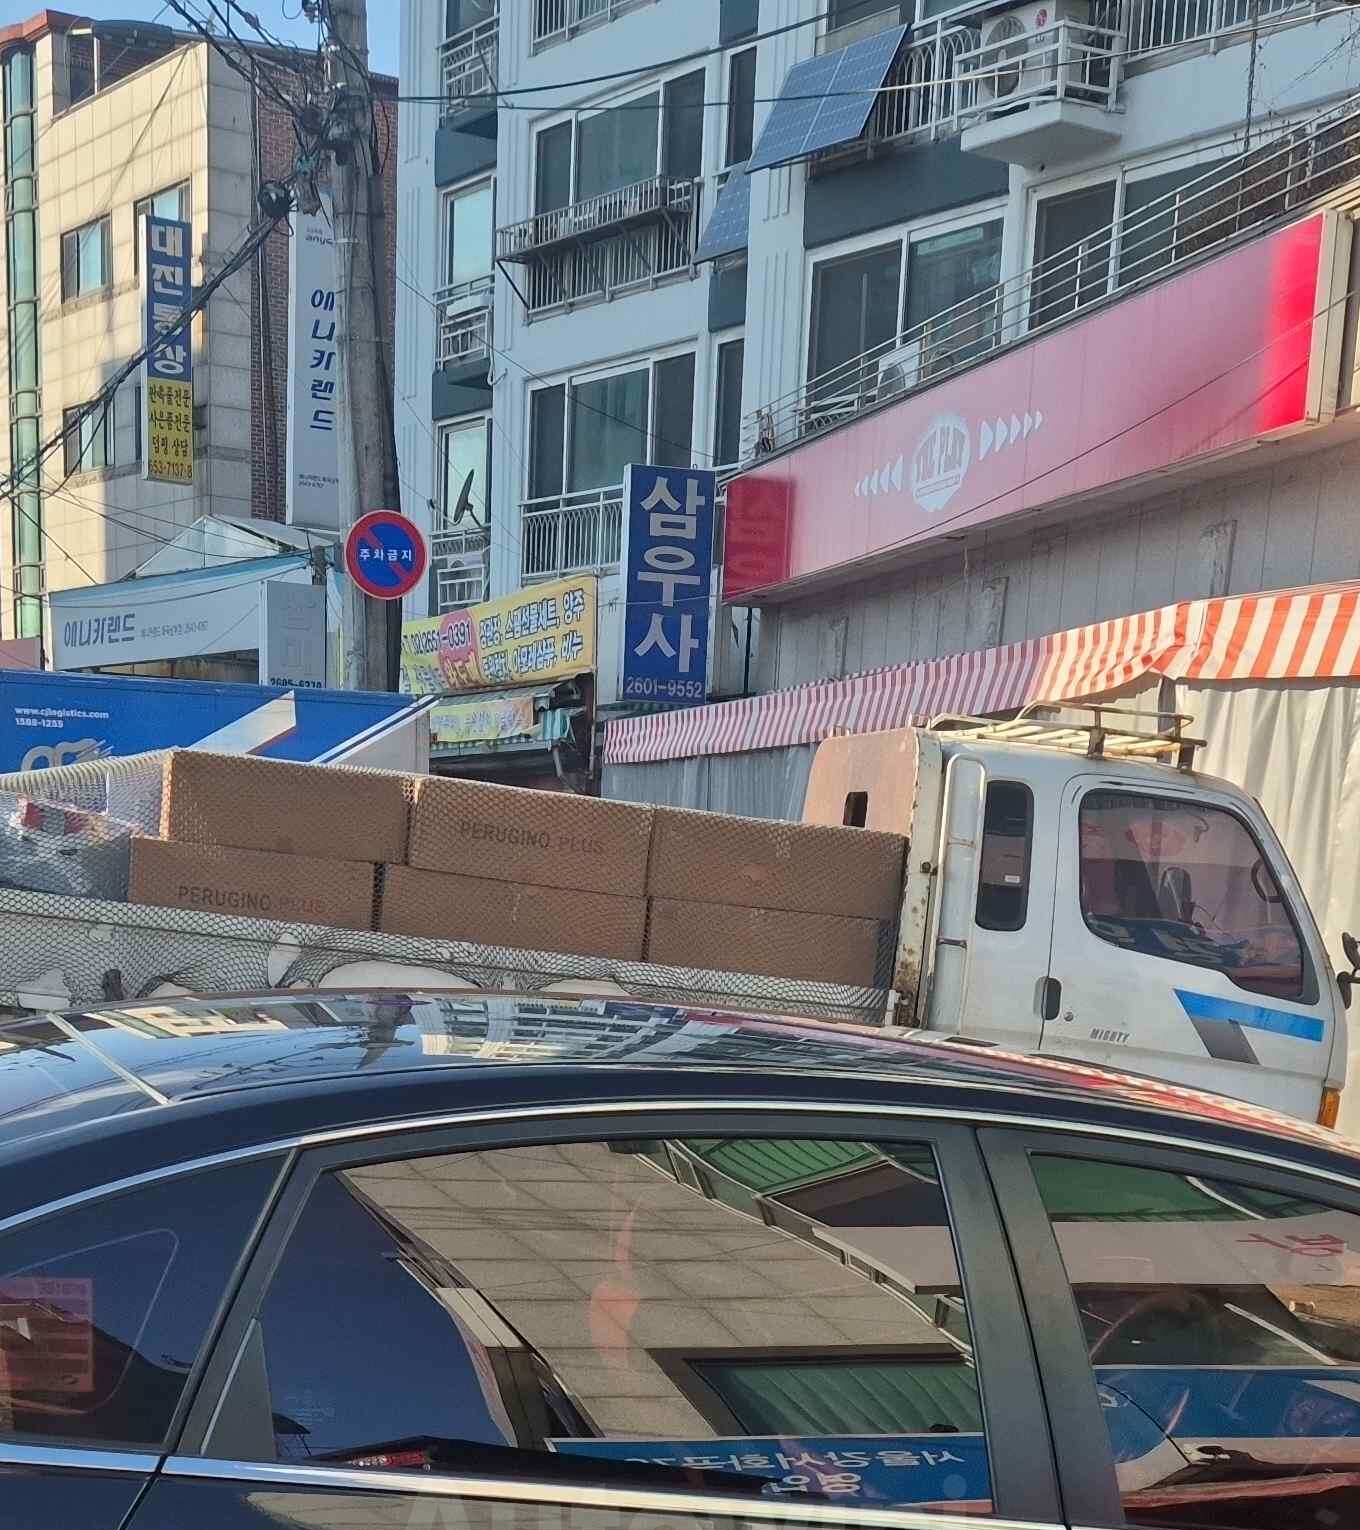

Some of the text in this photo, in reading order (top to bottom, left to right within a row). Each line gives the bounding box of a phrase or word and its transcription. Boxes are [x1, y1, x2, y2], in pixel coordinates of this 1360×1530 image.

[359, 548, 412, 562] 주차금지
[633, 476, 706, 674] 삼우사
[562, 588, 584, 625] 양주
[64, 613, 136, 648] 애니카랜드
[625, 675, 703, 699] 2601-9552
